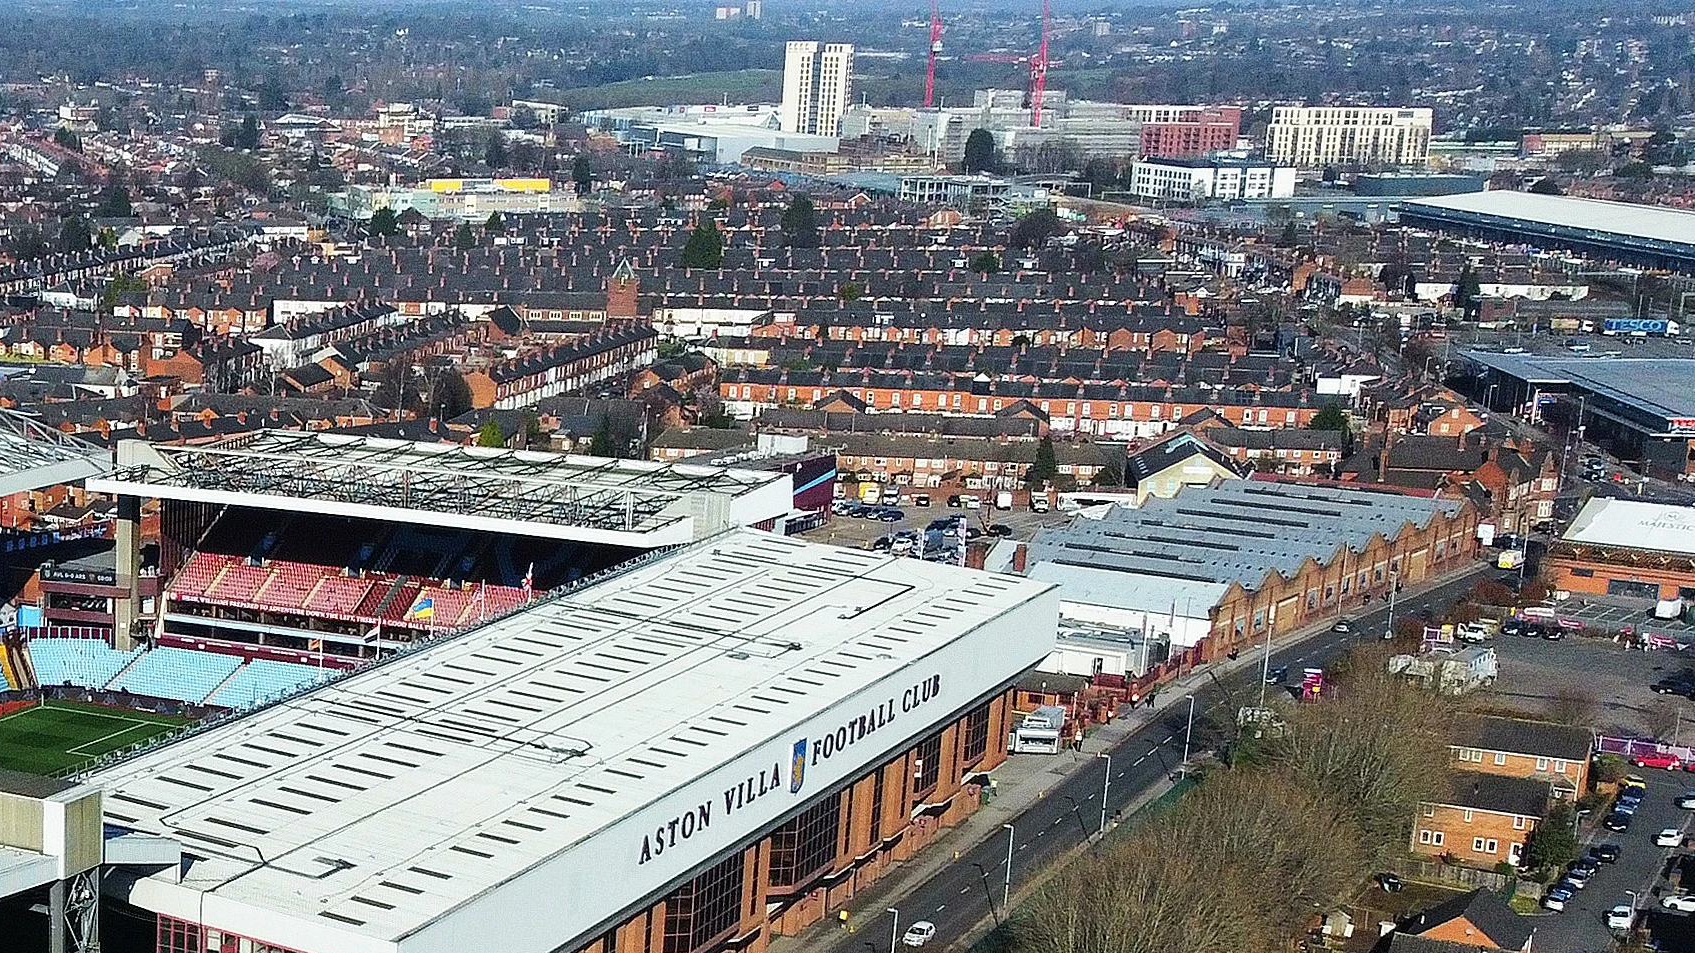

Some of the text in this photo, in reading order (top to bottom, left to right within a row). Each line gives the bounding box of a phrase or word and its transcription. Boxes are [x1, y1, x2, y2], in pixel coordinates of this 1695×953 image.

[1611, 320, 1662, 332] TESCO
[1638, 520, 1694, 531] MAJESTIC
[638, 674, 941, 865] ASTON VILLA FOOTBALL CLUB
